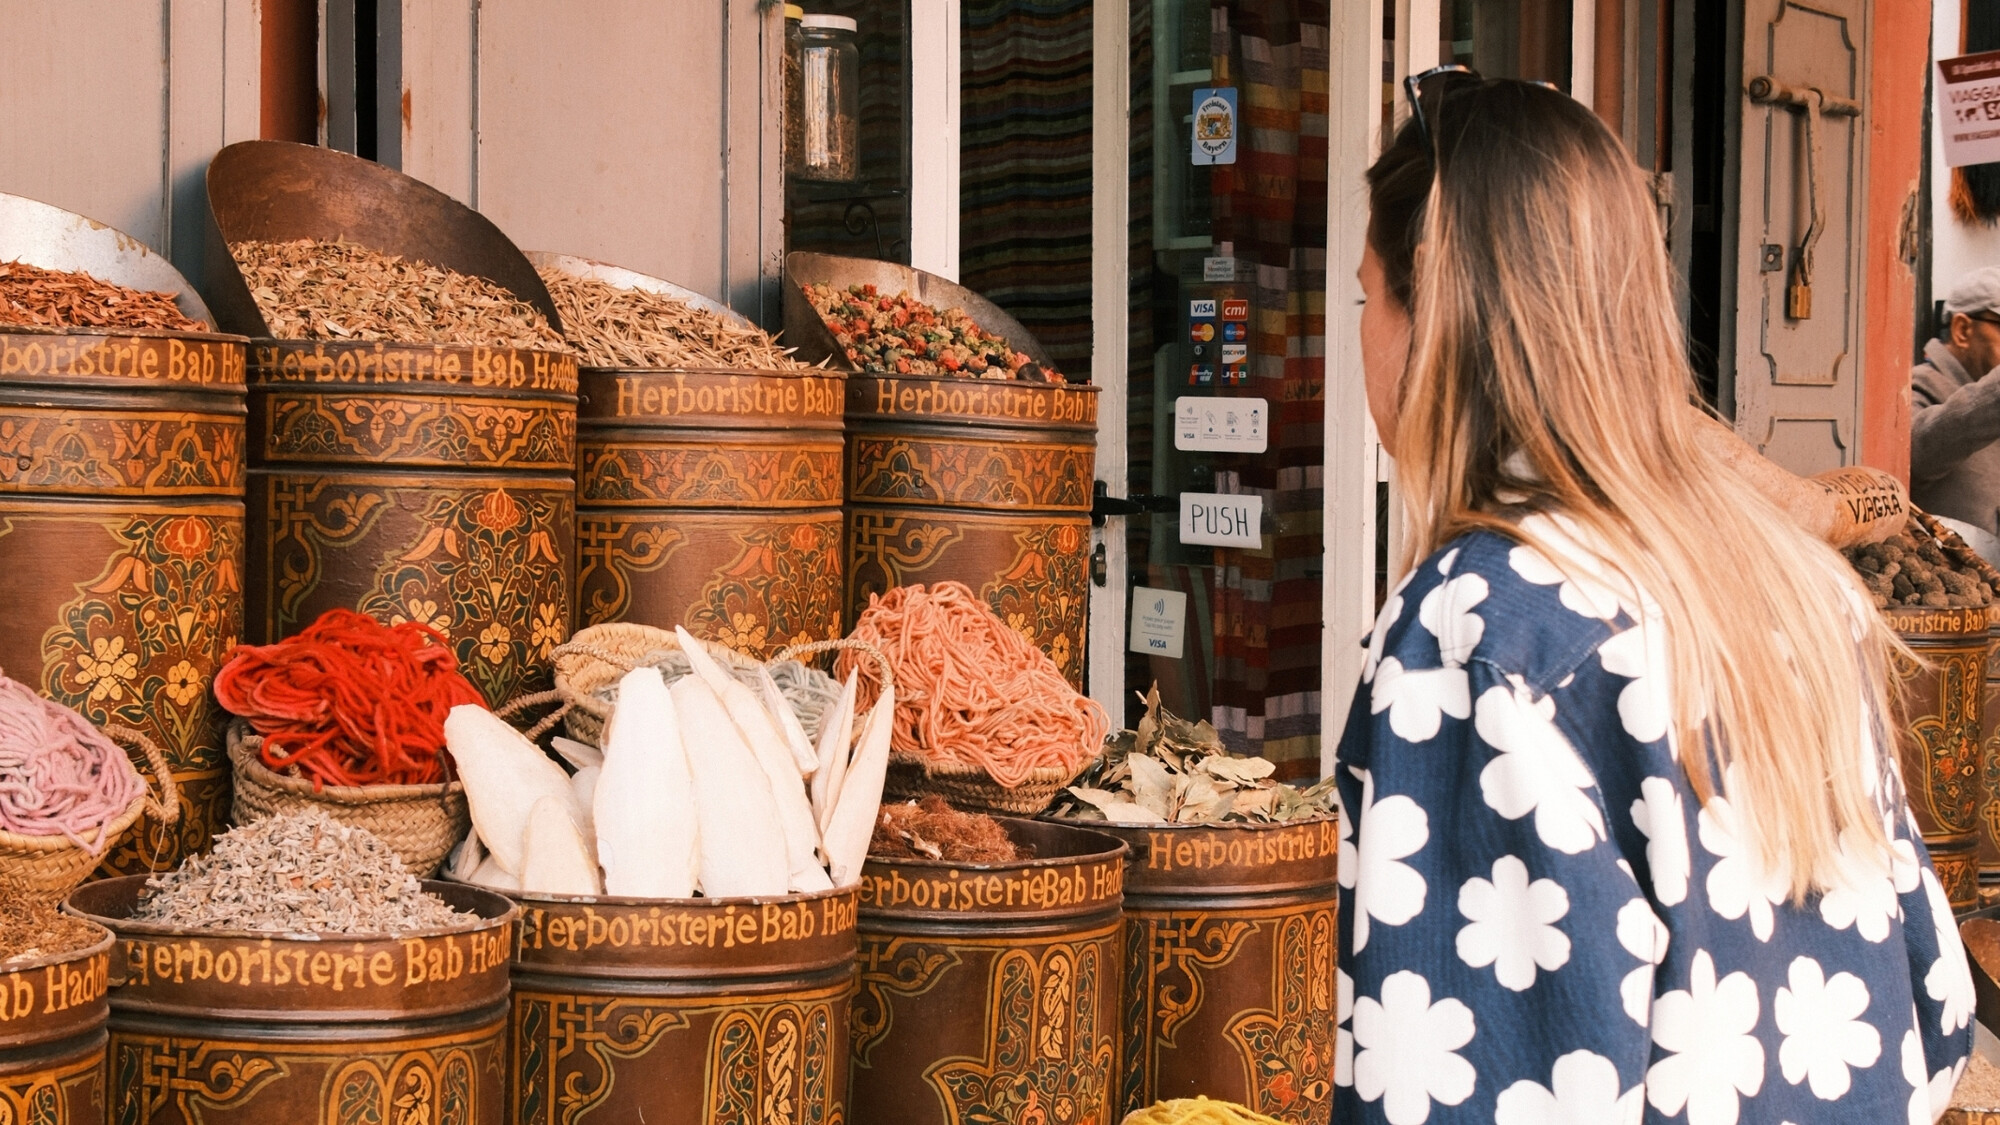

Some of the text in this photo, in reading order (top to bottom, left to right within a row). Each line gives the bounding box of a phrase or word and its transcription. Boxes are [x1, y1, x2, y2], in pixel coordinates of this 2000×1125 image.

[1202, 140, 1227, 154] Bayern
[1193, 303, 1214, 313] VISA
[168, 338, 215, 385] Bab
[256, 342, 461, 385] Herboristrie
[472, 346, 526, 388] Bab
[1222, 371, 1247, 379] JCB
[616, 374, 799, 416] Herboristrie
[803, 375, 833, 416] Bab
[876, 378, 1047, 418] Herboristrie
[1051, 388, 1083, 424] Bab
[1191, 504, 1249, 537] PUSH
[1847, 494, 1902, 524] VIAGRA
[1963, 607, 1984, 634] Bab
[1148, 638, 1167, 649] VISA
[1148, 820, 1338, 871] Herboristrie Ba
[858, 868, 1044, 910] erboristerie
[1042, 865, 1086, 909] Bab
[522, 905, 758, 950] Herboristerie
[761, 902, 815, 944] Bab
[127, 938, 397, 990] Herboristerie
[401, 934, 464, 988] Bab
